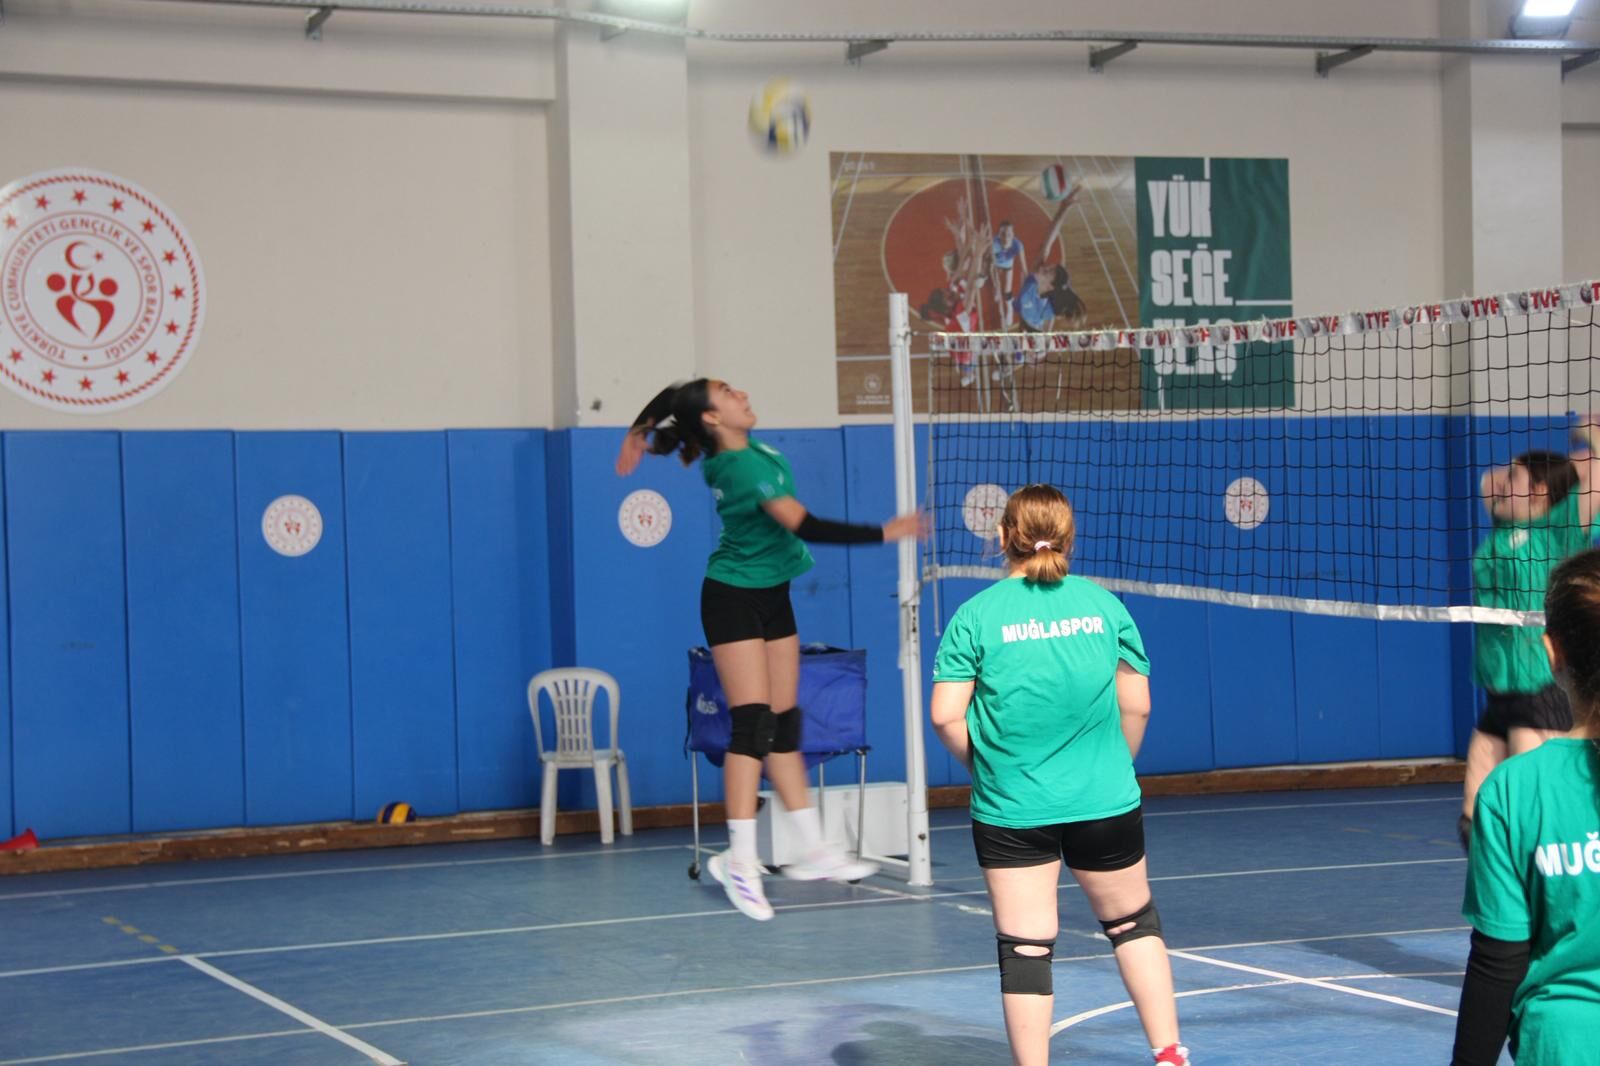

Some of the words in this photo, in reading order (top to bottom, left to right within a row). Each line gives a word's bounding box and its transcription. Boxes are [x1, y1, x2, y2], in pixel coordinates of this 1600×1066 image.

[1147, 174, 1212, 237] YÜK
[124, 236, 140, 254] VE
[138, 256, 158, 294] SPOR
[1150, 243, 1233, 306] SEĞE
[1471, 296, 1499, 317] TVF
[1530, 289, 1561, 310] TVF
[1001, 616, 1104, 643] MUĞLASPOR
[1535, 831, 1600, 877] MUĞ
